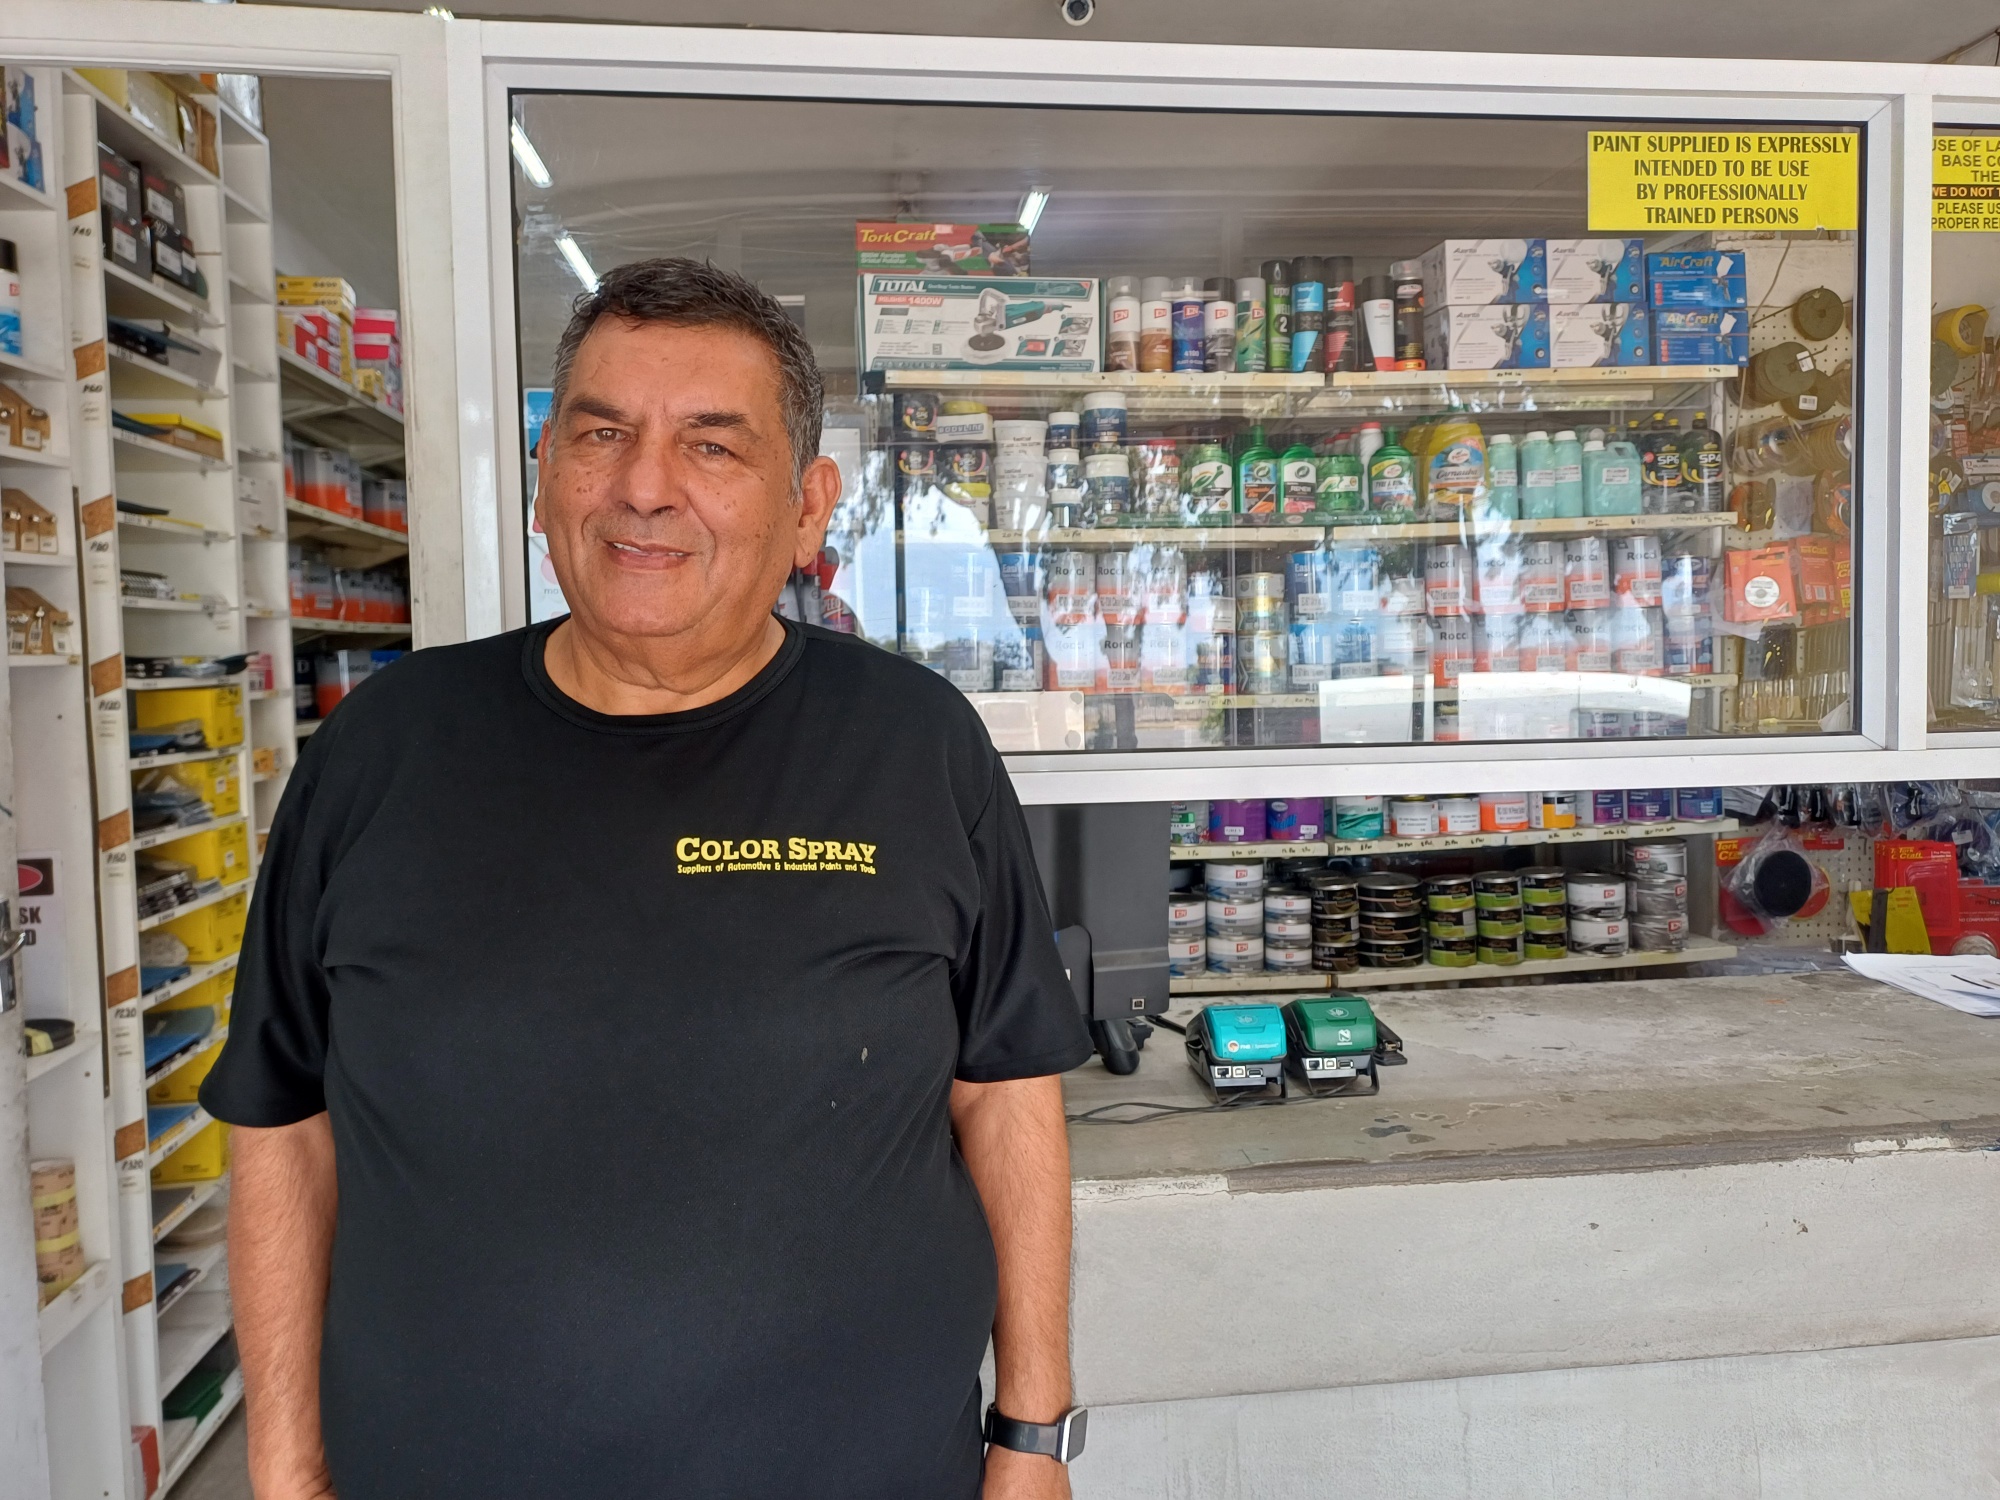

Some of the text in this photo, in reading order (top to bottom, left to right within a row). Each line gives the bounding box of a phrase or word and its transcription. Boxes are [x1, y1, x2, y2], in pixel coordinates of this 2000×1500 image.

[1593, 136, 1851, 154] PAINT SUPPLIED IS EXPRESSLY
[1961, 139, 1982, 152] OF
[1941, 155, 1981, 167] BASE
[1634, 159, 1810, 177] INTENDED TO BE USE
[1970, 170, 2000, 182] THE
[1636, 183, 1808, 201] BY PROFESSIONALLY
[1932, 187, 1948, 197] WE
[1950, 187, 1967, 197] DO
[1970, 187, 1994, 197] NOT
[1937, 202, 1984, 215] PLEASE
[1644, 207, 1799, 224] TRAINED PERSONS
[1932, 217, 1980, 229] PROPER
[878, 280, 927, 293] TOTAL
[908, 297, 943, 305] 1400W
[1522, 556, 1553, 566] Rocci
[1104, 640, 1134, 649] Rocci
[676, 837, 877, 864] COLOR SPRAY
[677, 861, 876, 875] Suppliers of Automotive & Industrial Paints and Tools
